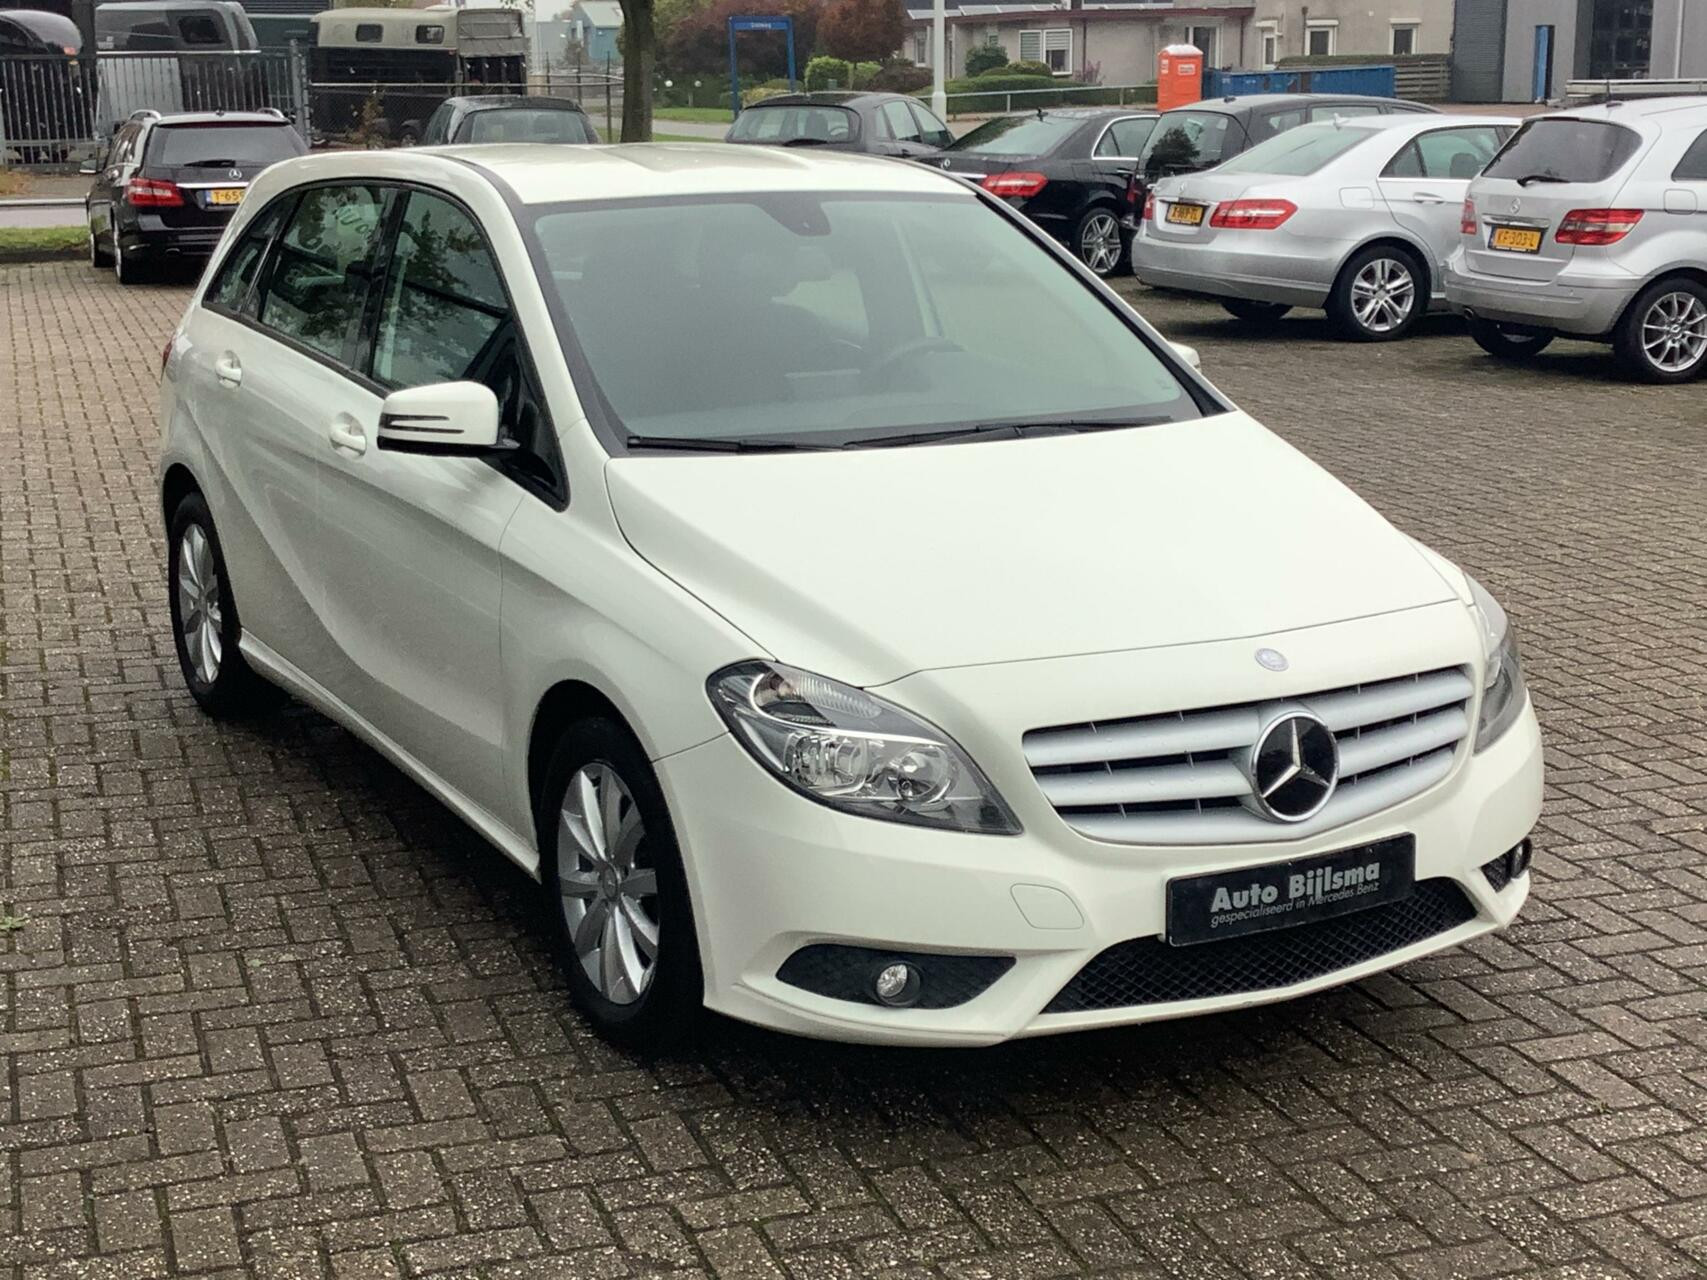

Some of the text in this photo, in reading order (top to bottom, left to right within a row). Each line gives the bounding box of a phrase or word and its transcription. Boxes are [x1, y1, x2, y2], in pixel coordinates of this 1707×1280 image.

[1210, 862, 1380, 913] Auto Bijlsma
[1211, 882, 1379, 928] gespecialiseerd in Mercedes Benz
